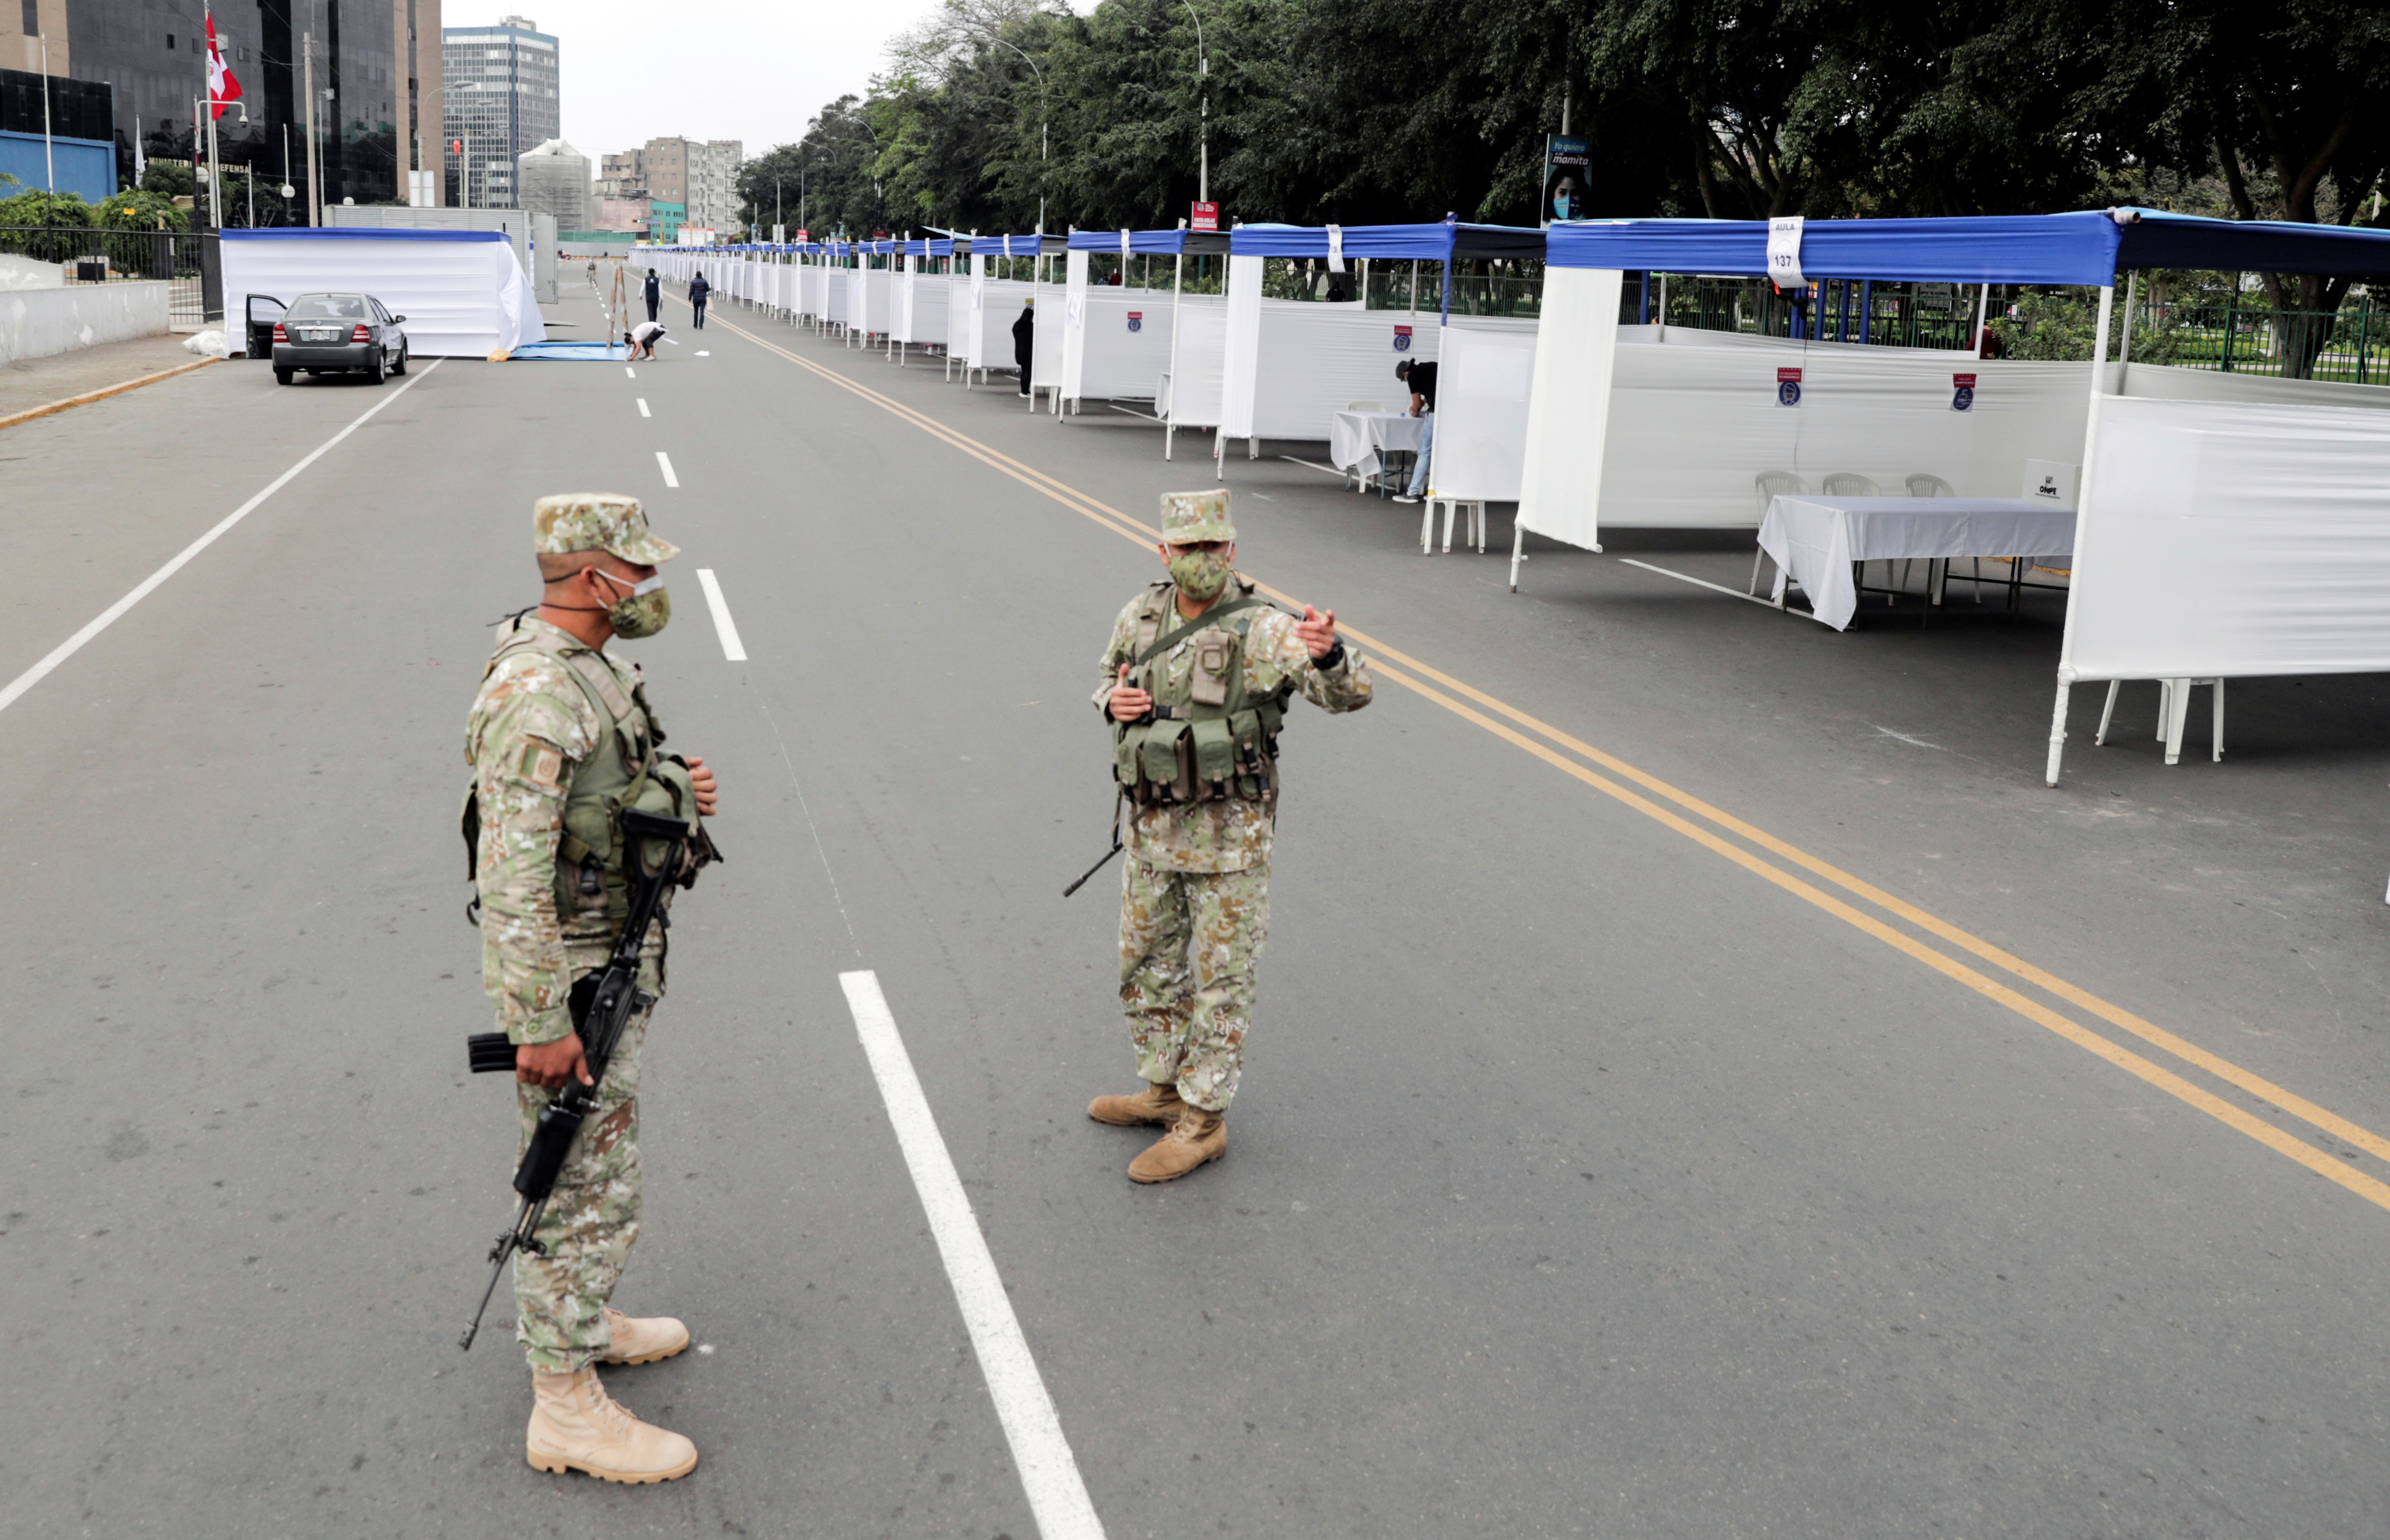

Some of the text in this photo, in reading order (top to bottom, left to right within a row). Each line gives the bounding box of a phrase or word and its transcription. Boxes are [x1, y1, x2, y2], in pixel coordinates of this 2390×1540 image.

[1563, 142, 1585, 152] quiero
[149, 157, 193, 168] MINISTERI
[1552, 155, 1589, 165] mamita
[1775, 255, 1791, 266] 137
[2039, 486, 2056, 495] ONPE
